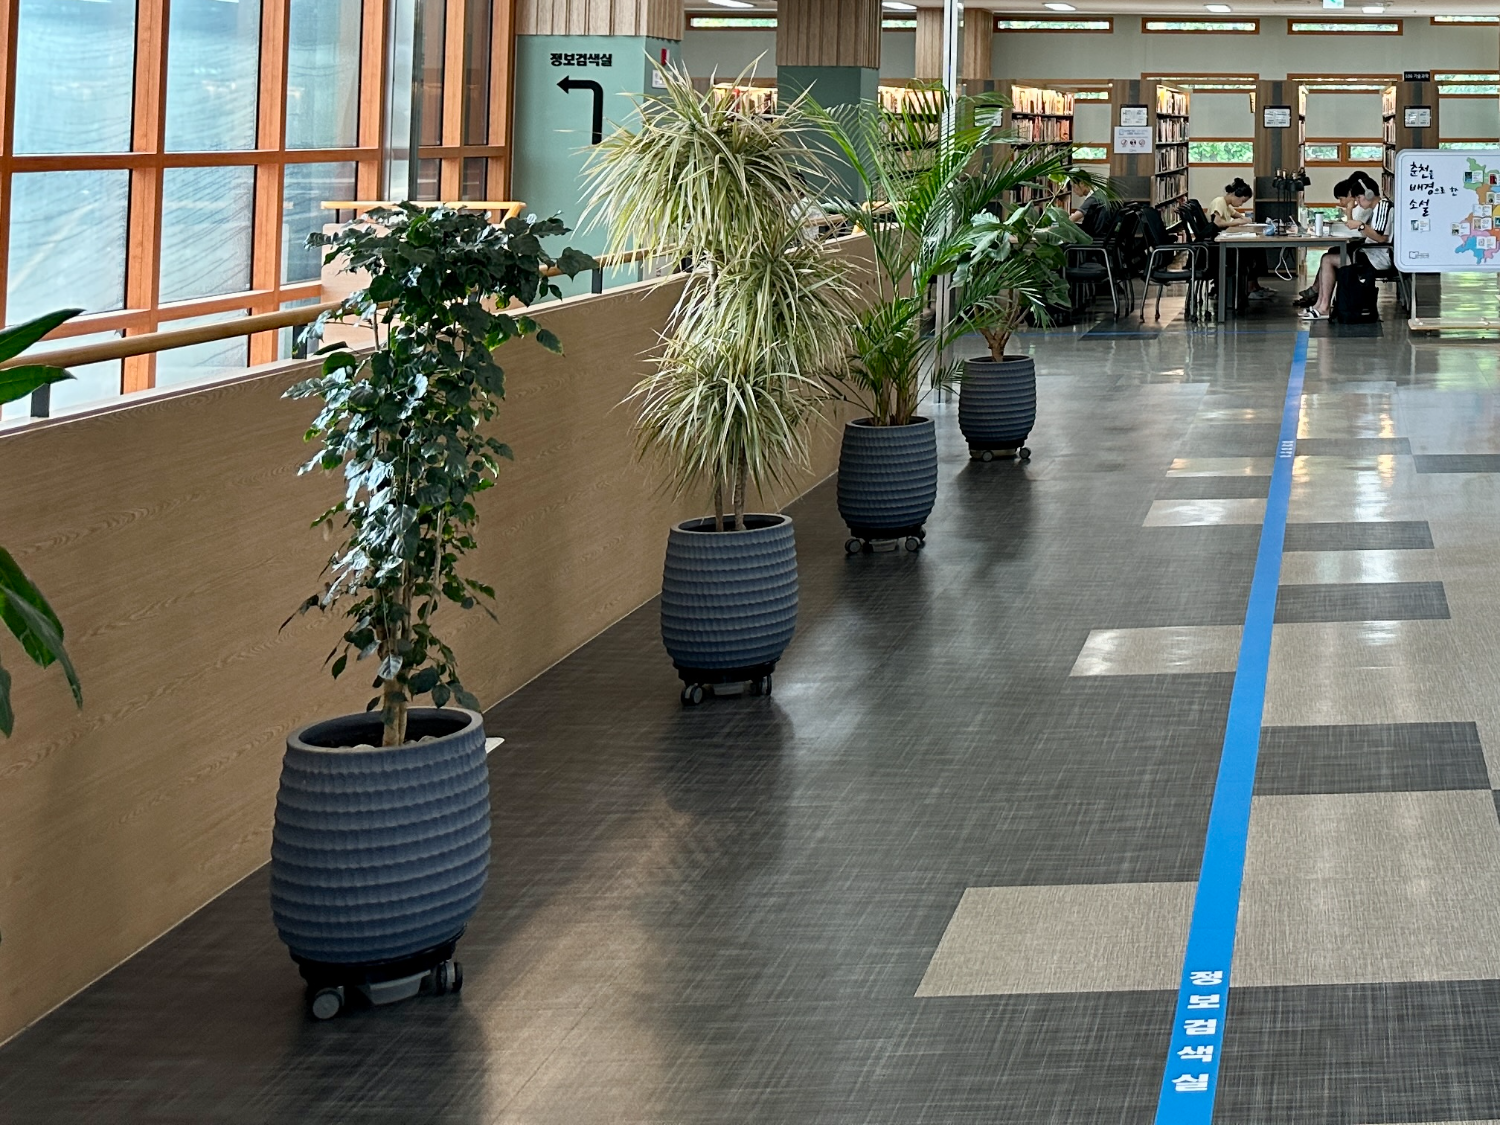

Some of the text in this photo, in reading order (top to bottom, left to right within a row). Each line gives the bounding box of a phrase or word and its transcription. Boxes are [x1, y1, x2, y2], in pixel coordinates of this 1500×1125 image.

[550, 53, 613, 67] 정보검색실
[1409, 161, 1434, 180] 춘천을
[1409, 181, 1459, 197] 배경으로 한
[1409, 198, 1430, 217] 소설
[1172, 971, 1223, 1091] 정보검색실
